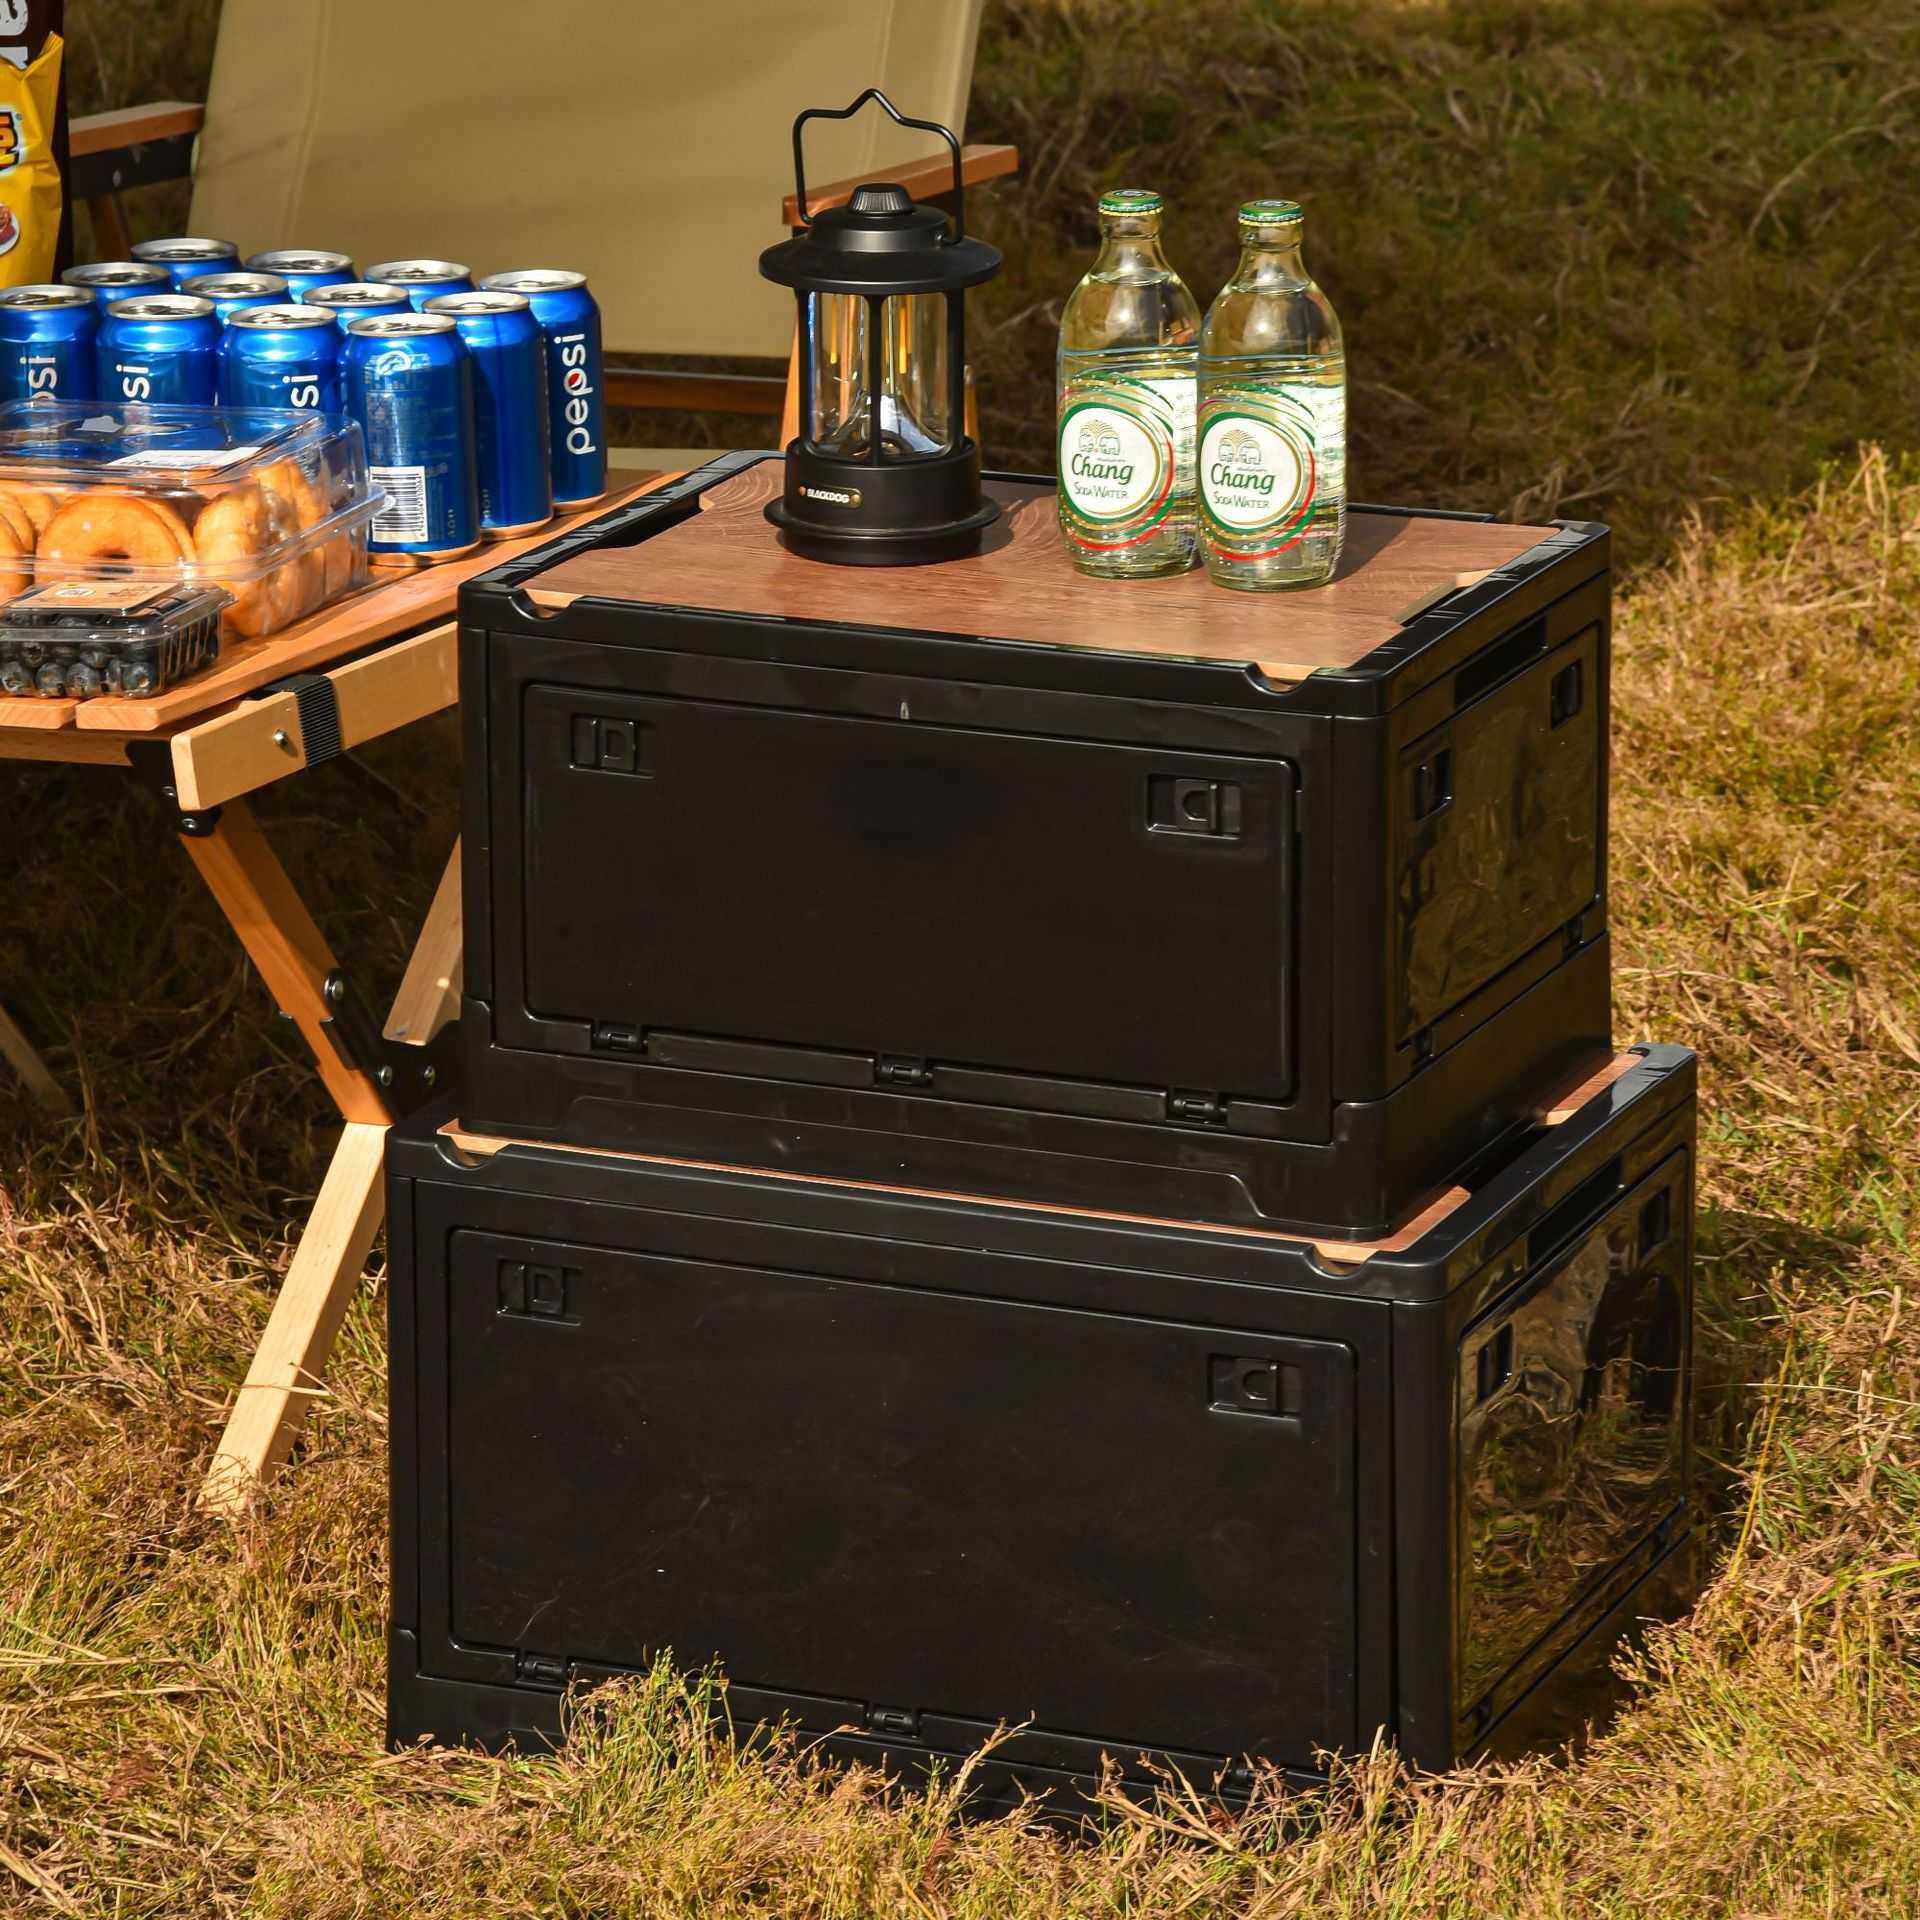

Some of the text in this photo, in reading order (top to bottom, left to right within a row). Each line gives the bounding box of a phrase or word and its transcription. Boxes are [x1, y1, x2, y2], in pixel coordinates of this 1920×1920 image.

[116, 364, 151, 404] si
[282, 374, 320, 408] si
[554, 333, 596, 455] pepsi
[1071, 453, 1136, 486] Chang
[1210, 462, 1277, 495] Chang
[806, 488, 851, 504] BLACKDOG
